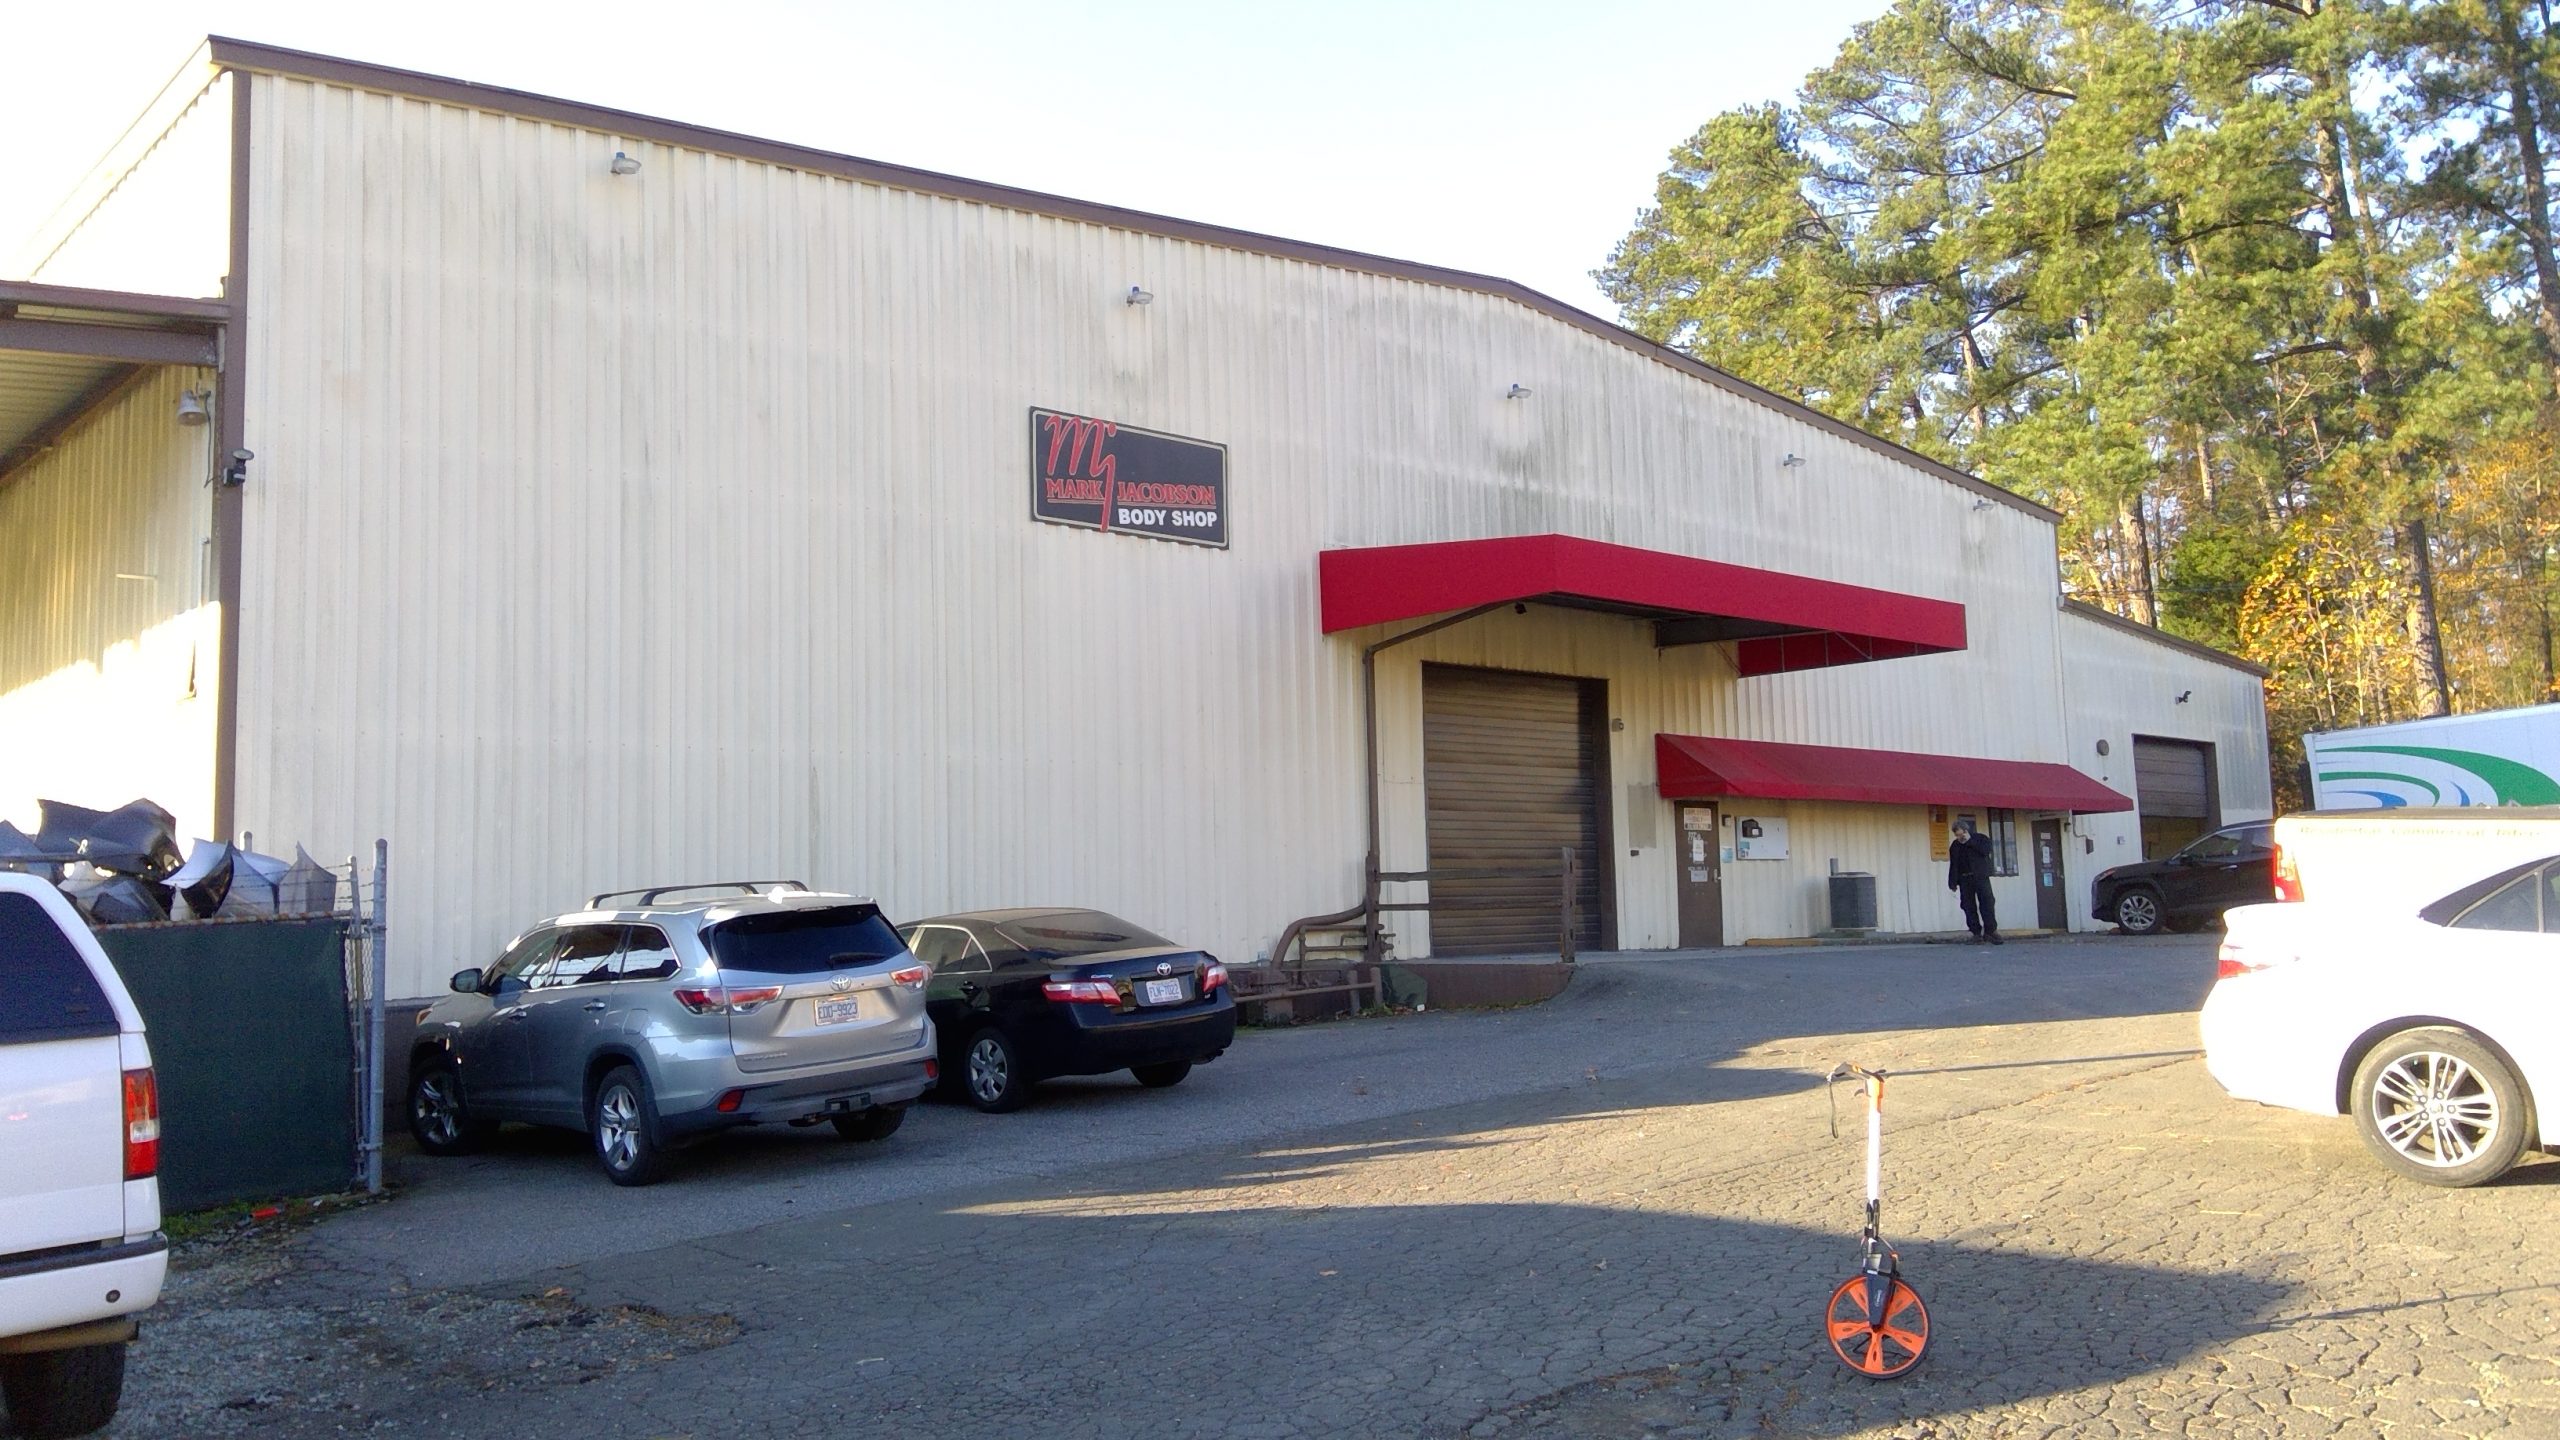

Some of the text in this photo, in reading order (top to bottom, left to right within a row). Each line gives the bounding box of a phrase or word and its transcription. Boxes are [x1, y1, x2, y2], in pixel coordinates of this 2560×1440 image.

[1045, 478, 1216, 505] MARK JACOBSON
[1118, 508, 1218, 528] BODY SHOP
